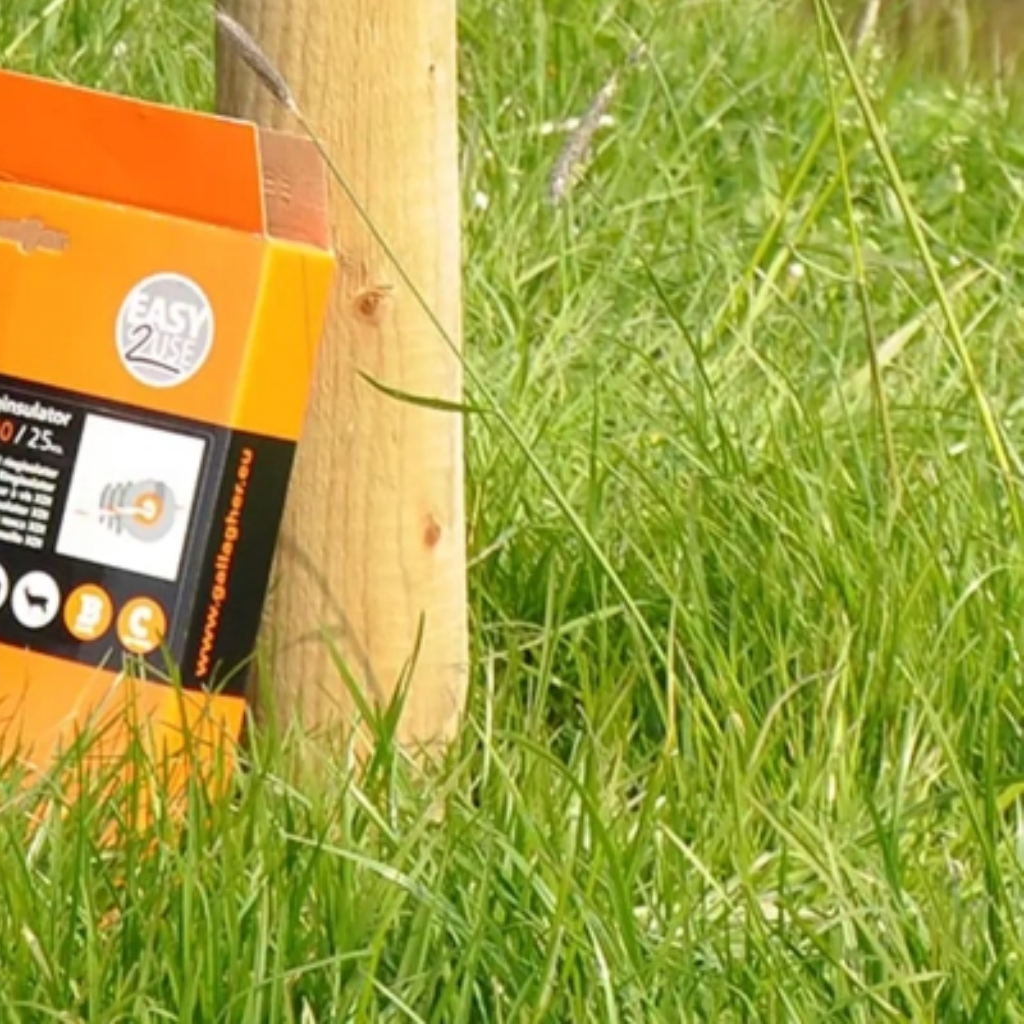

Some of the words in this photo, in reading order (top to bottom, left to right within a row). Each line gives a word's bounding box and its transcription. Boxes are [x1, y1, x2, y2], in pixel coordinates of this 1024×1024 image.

[127, 292, 207, 338] EASY
[195, 448, 253, 677] www.gallagher.eu
[129, 606, 153, 638] C
